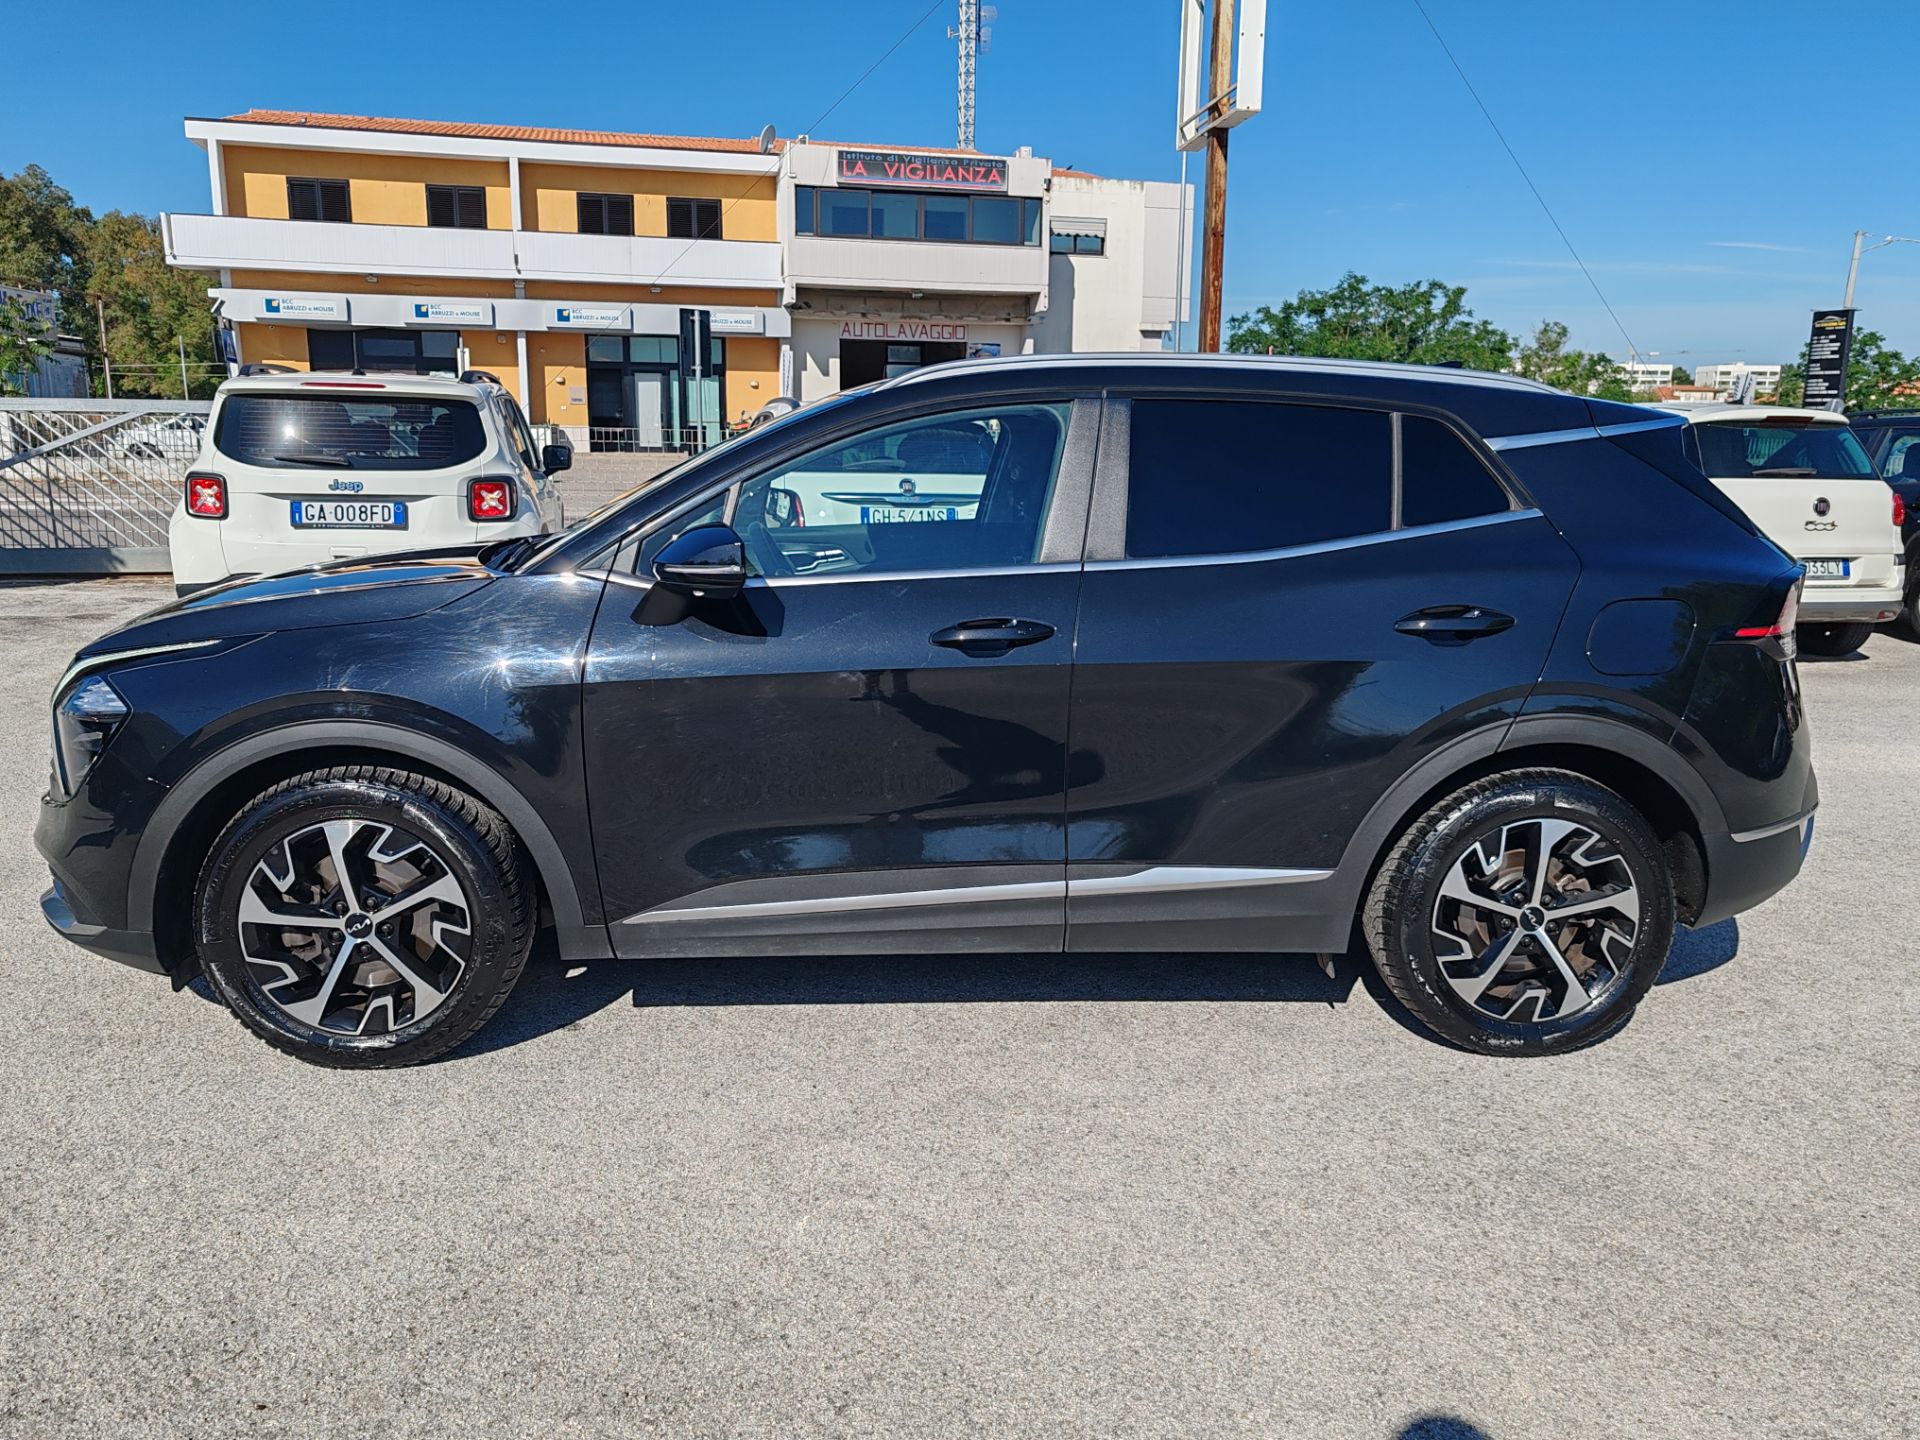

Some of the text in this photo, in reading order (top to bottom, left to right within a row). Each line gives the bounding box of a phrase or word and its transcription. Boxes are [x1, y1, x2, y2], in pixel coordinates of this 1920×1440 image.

[887, 153, 898, 162] di
[843, 160, 1003, 184] LA VIGILANZA
[841, 322, 966, 340] AUTOLAVAGGIO
[328, 478, 364, 493] Jeep
